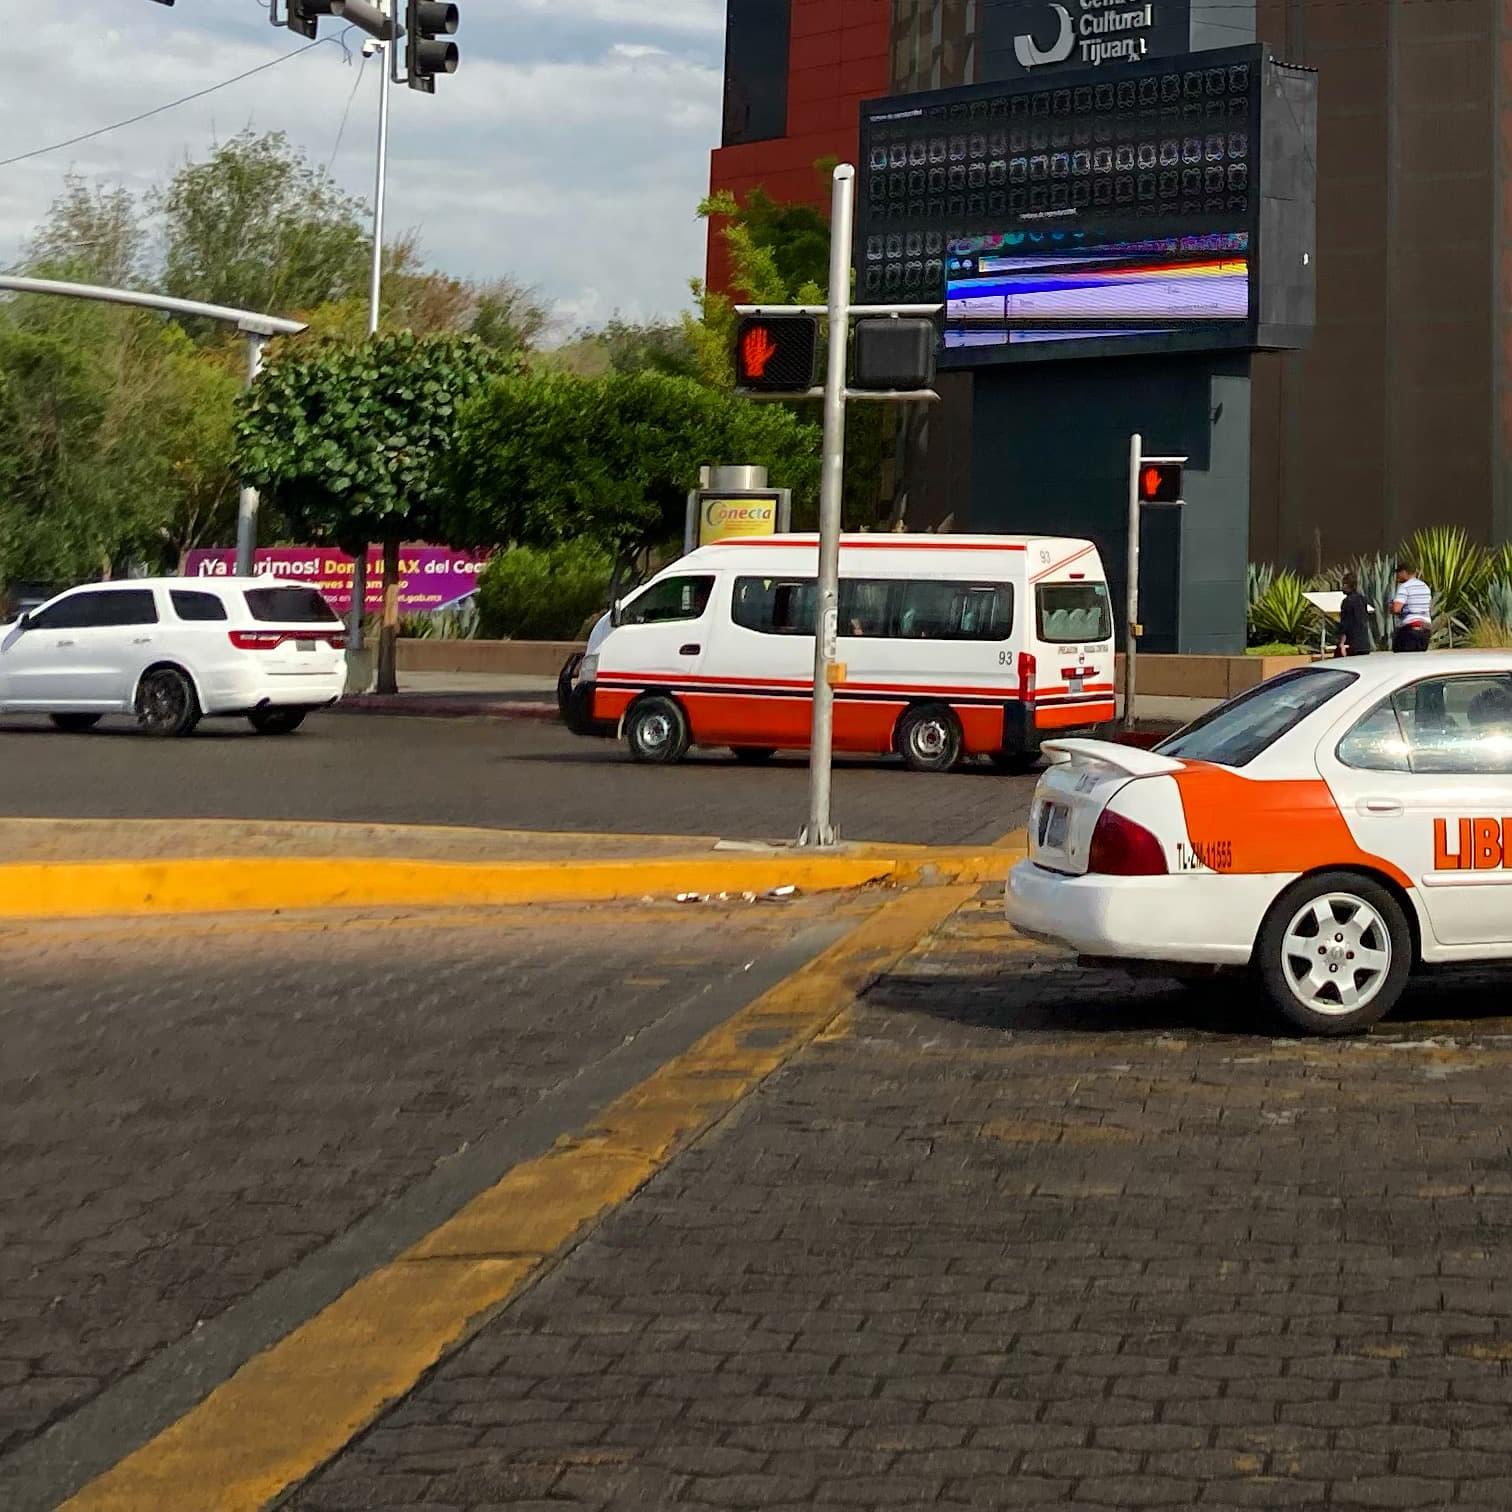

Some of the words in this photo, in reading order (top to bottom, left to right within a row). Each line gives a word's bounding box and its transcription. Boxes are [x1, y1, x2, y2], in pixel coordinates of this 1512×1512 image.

[1080, 3, 1152, 36] Cultural
[706, 501, 772, 526] Conecta
[1039, 550, 1051, 564] 93
[424, 559, 449, 575] del
[998, 650, 1013, 665] 93
